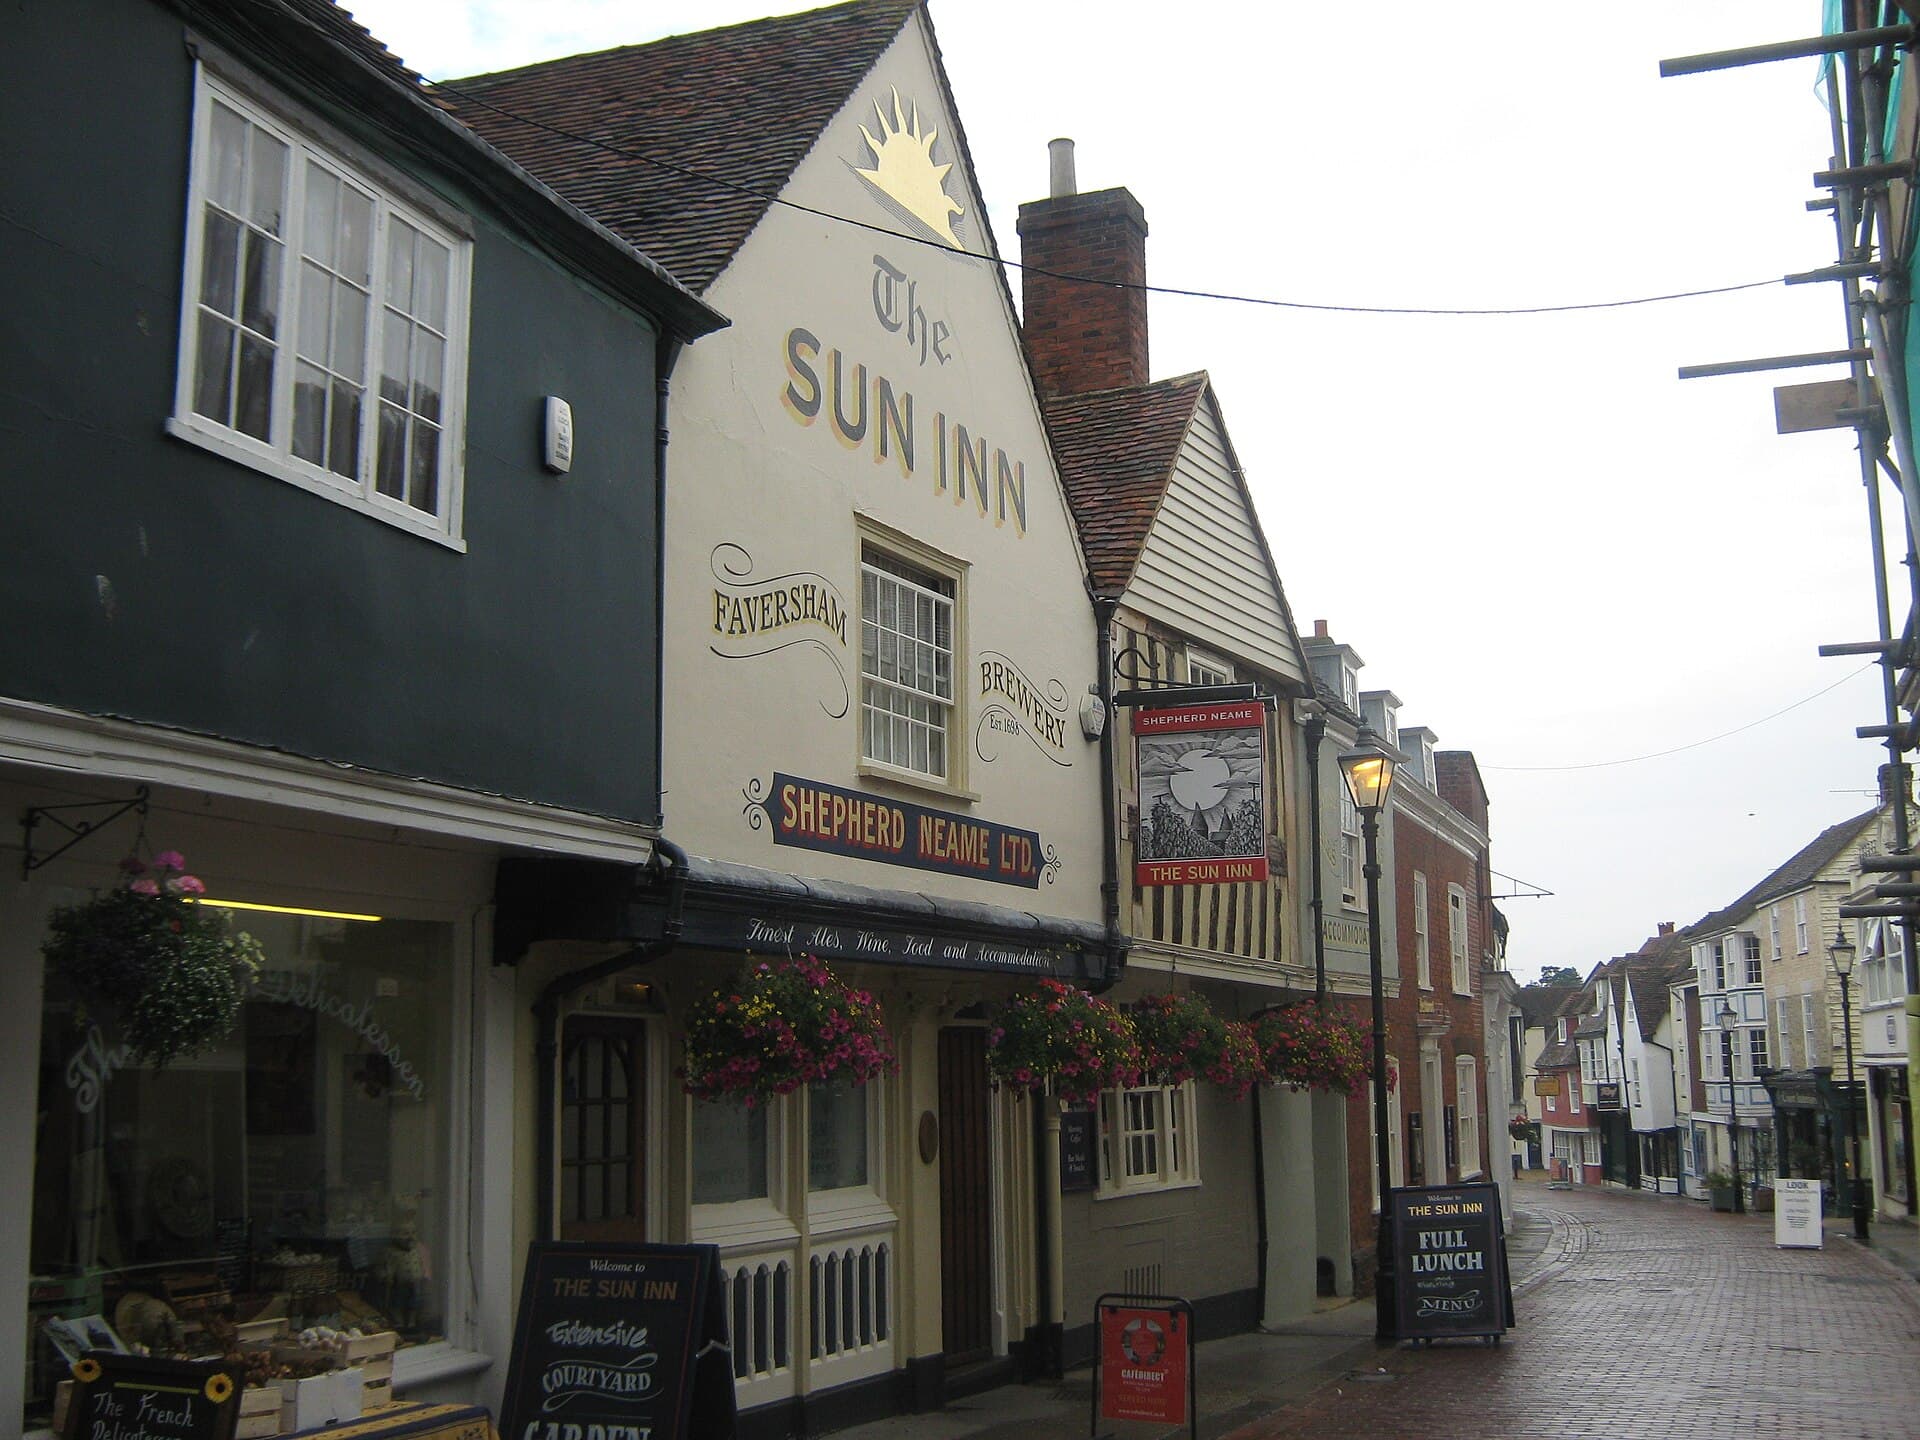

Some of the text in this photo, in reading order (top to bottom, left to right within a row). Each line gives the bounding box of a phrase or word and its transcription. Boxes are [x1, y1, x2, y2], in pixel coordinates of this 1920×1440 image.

[872, 254, 952, 367] The
[780, 327, 1027, 541] SUN INN
[713, 583, 848, 648] FAVERSHAM
[980, 661, 1066, 750] BREWERY
[1143, 710, 1253, 726] SHEPHERD NEAME
[780, 784, 1037, 877] SHEPHERD NEAME LTD.
[1151, 863, 1253, 881] THE SUN INN
[746, 917, 1050, 969] Finest Ales, Wine, Food and Accommodation
[1407, 1202, 1483, 1217] THE SUN INN
[1418, 1230, 1468, 1250] FULL
[589, 1259, 645, 1272] Welcome to
[1411, 1251, 1484, 1273] LUNCH
[552, 1278, 678, 1300] THE SUN INN
[1421, 1299, 1476, 1311] MENU
[545, 1319, 648, 1348] Extensive
[542, 1365, 651, 1393] COURTYARD
[93, 1392, 194, 1427] The French
